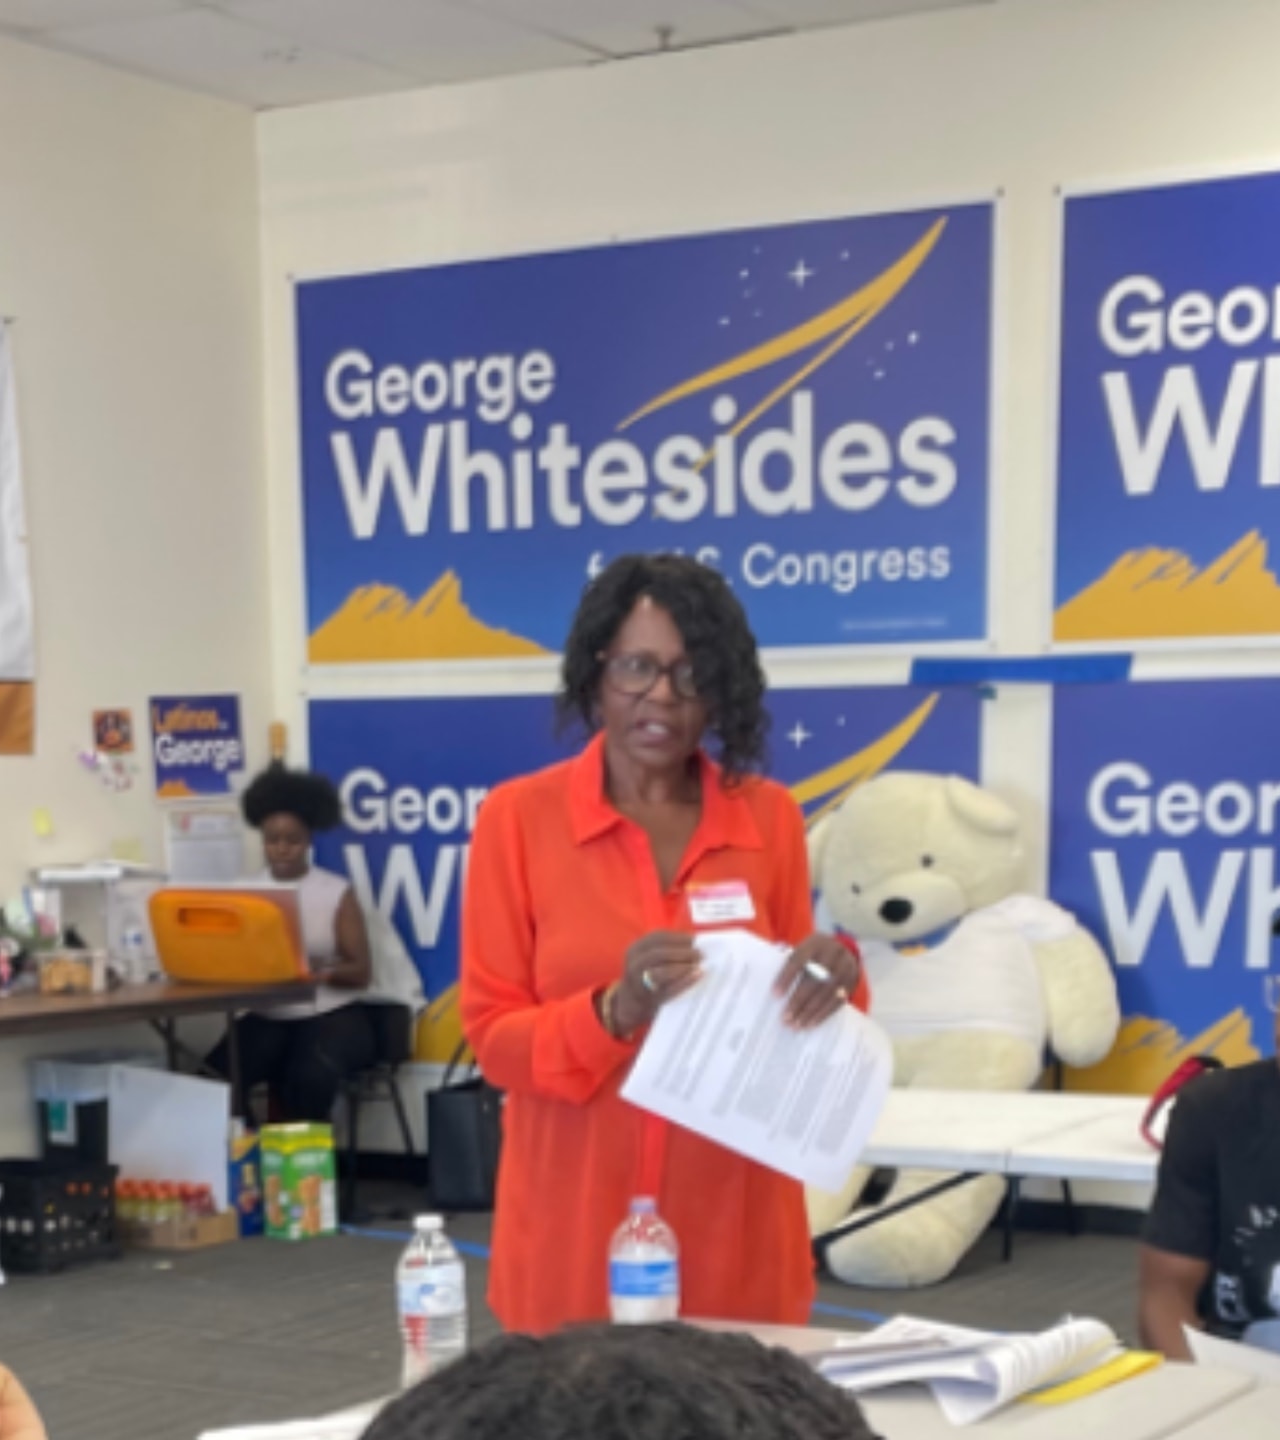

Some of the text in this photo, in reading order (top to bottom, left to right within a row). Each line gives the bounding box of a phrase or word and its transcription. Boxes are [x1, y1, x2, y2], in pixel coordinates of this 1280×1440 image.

[324, 349, 555, 423] George
[329, 389, 958, 541] Whitesides
[741, 541, 952, 594] Congress
[155, 733, 241, 772] George
[338, 766, 489, 835] Geor
